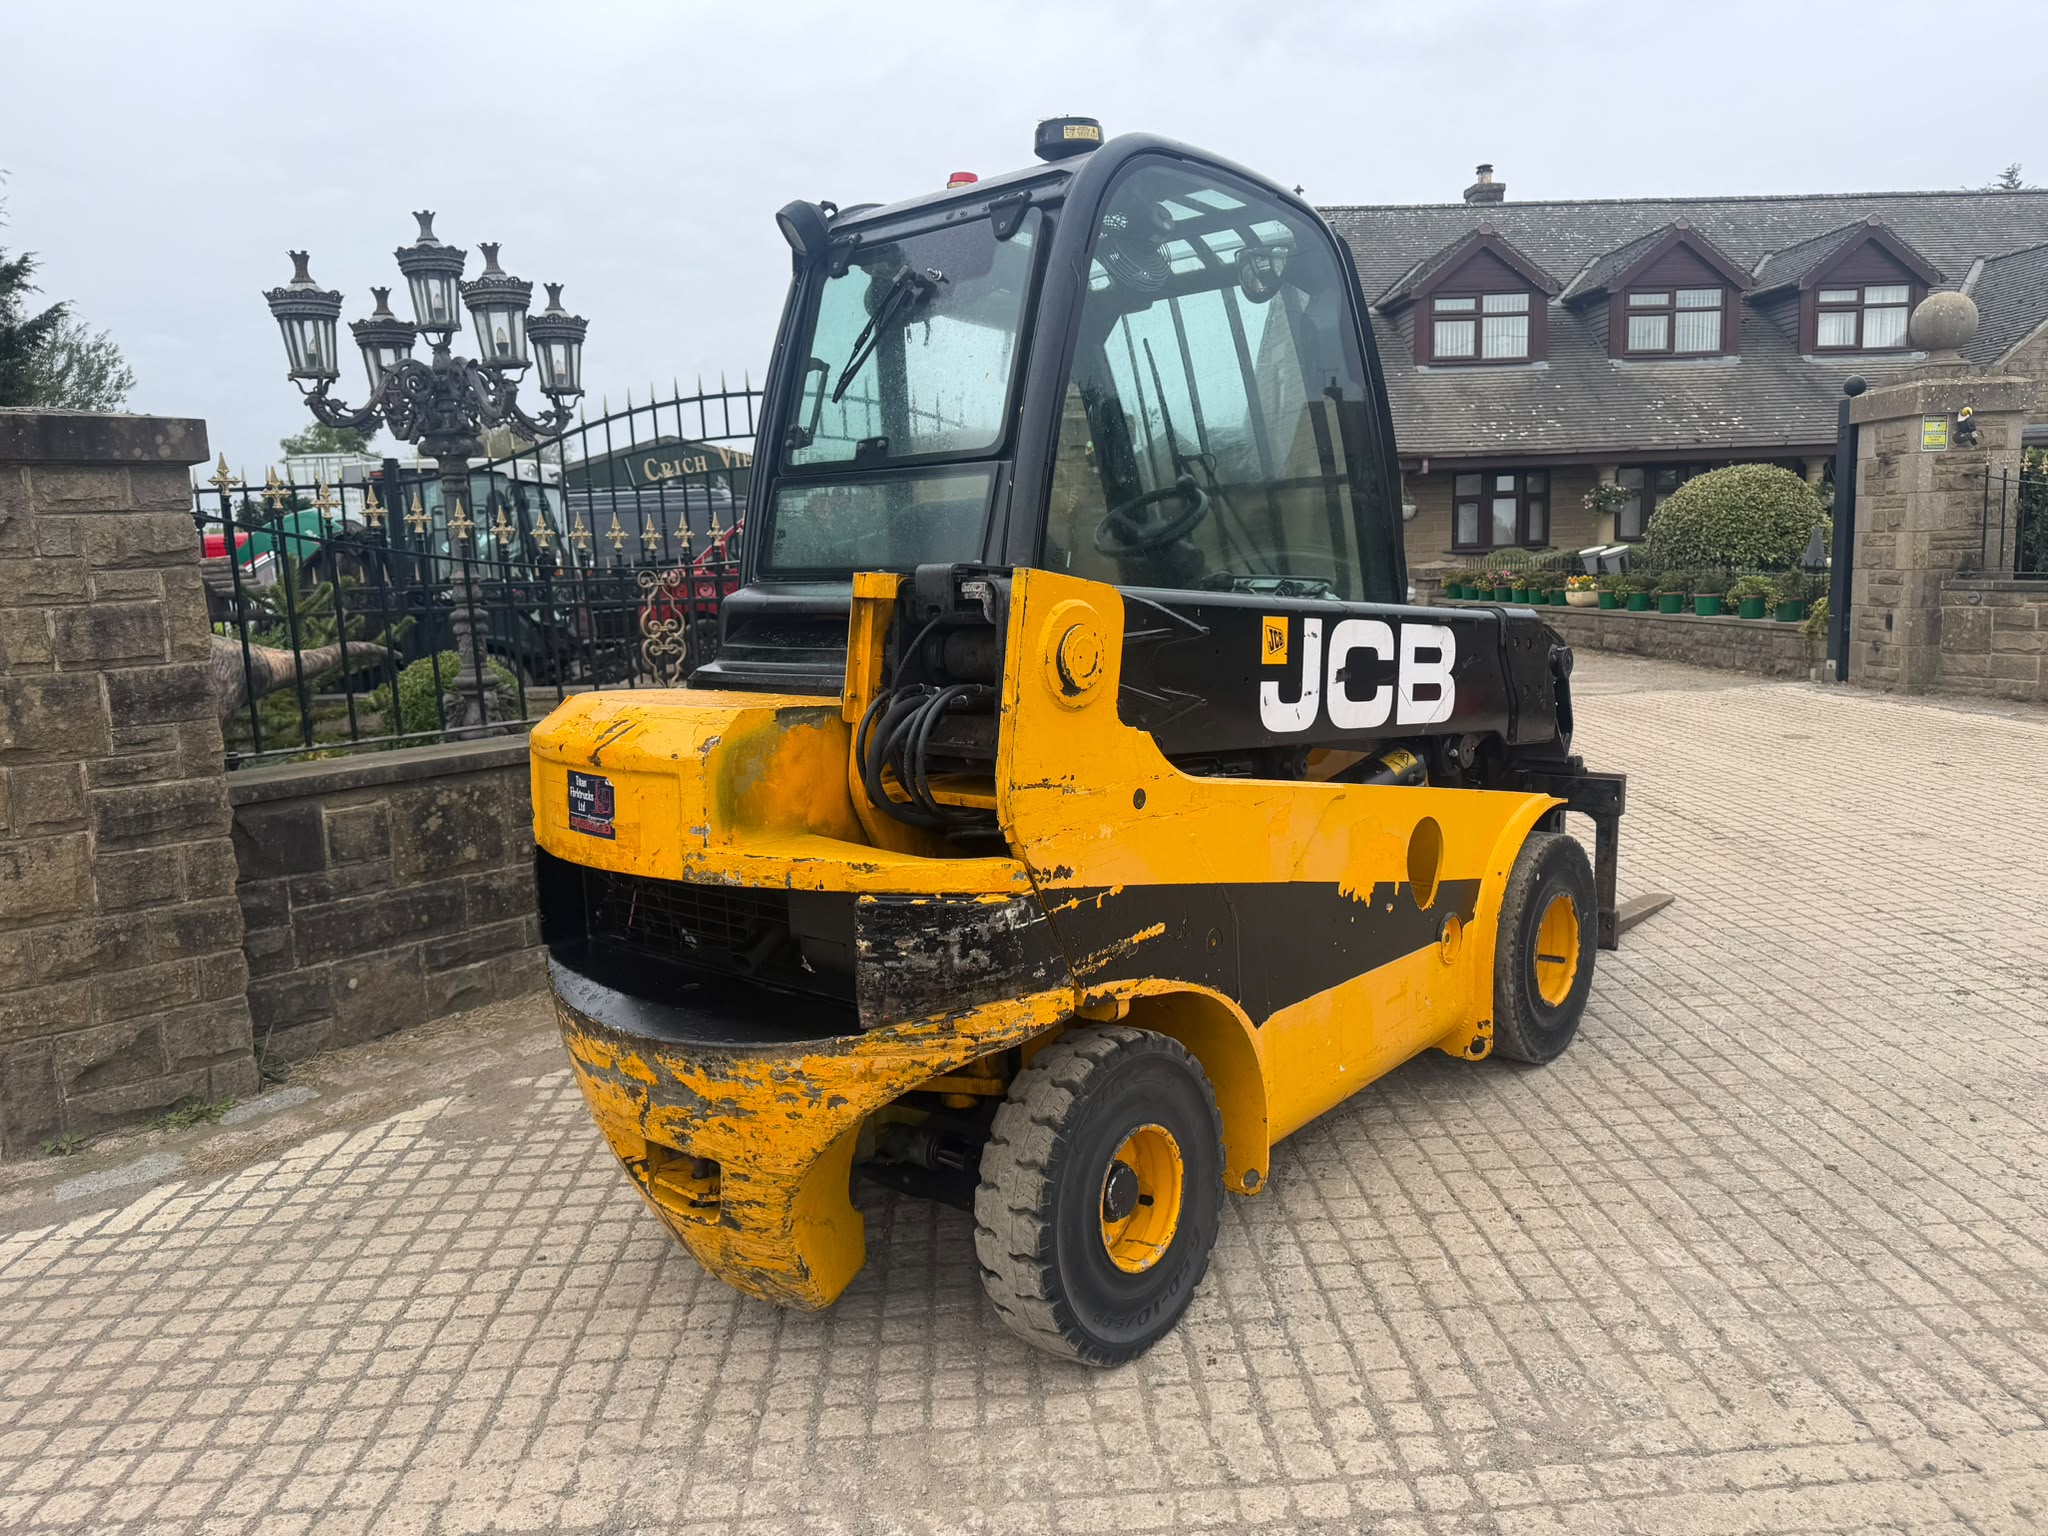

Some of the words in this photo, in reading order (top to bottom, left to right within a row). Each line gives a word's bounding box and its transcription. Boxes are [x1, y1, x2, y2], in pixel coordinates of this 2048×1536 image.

[1268, 628, 1285, 652] JCB
[1260, 618, 1456, 732] JCB
[575, 775, 588, 788] Titan
[577, 800, 586, 812] Ltd
